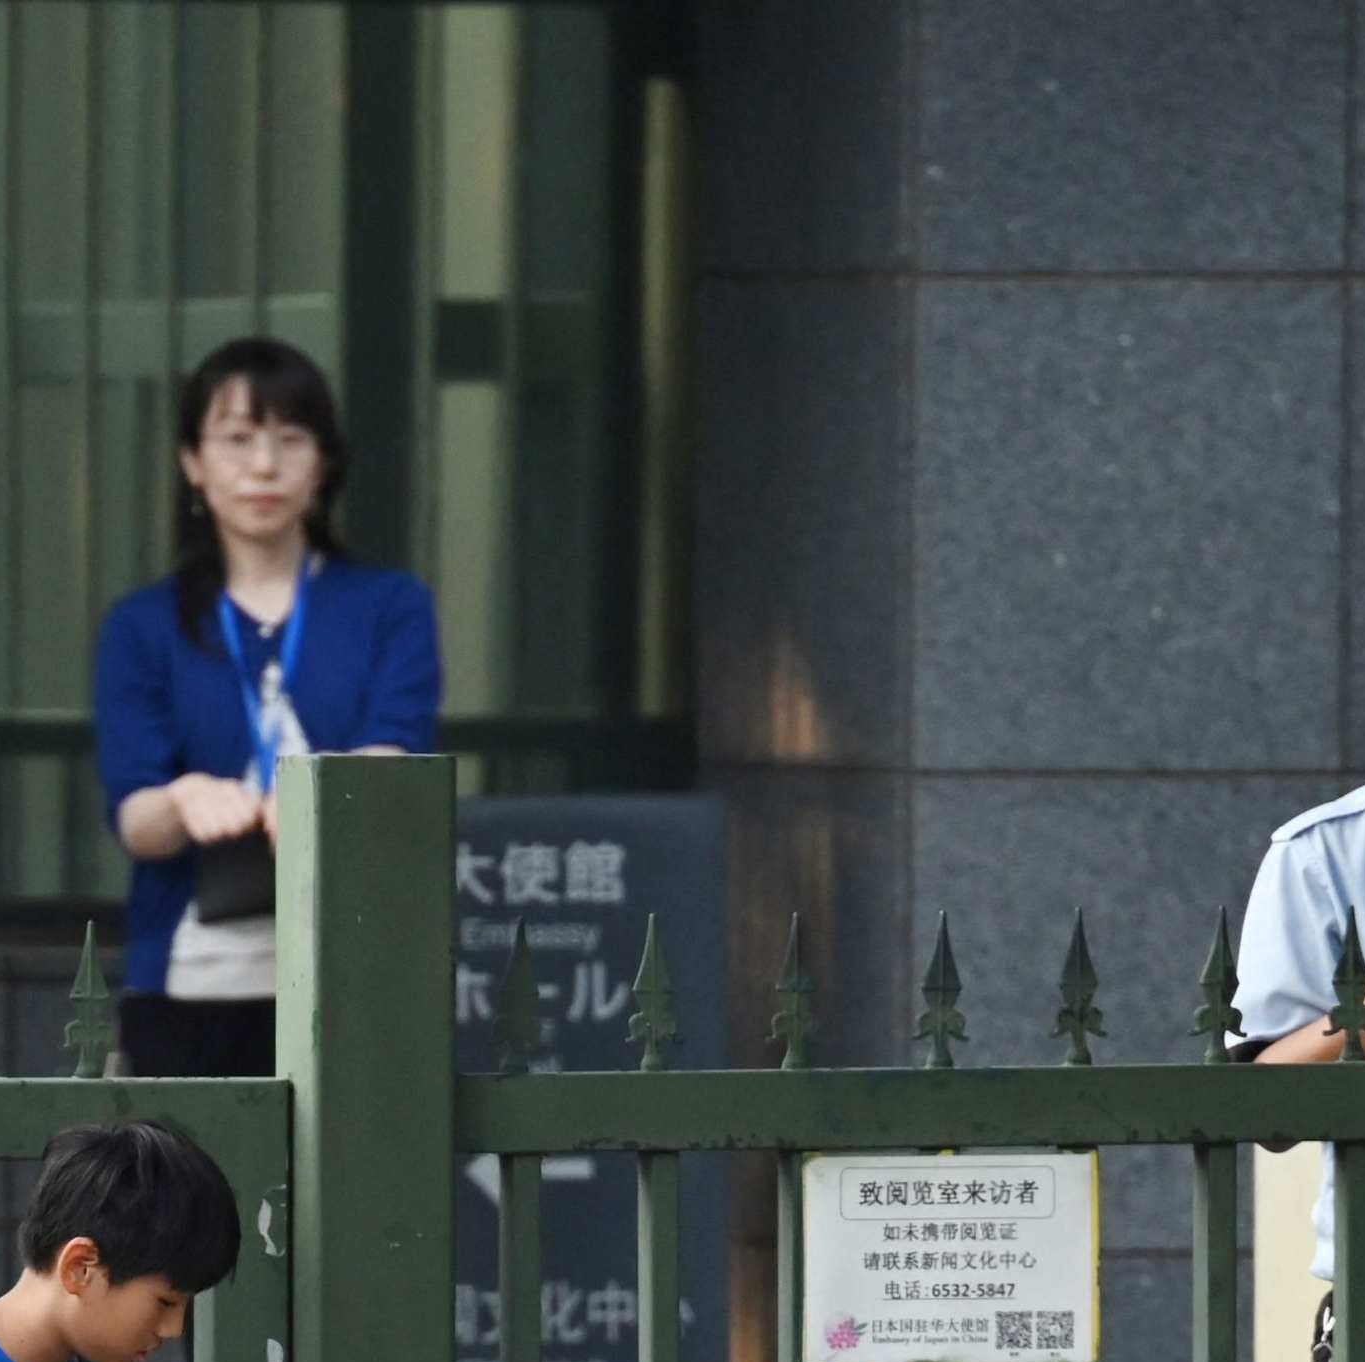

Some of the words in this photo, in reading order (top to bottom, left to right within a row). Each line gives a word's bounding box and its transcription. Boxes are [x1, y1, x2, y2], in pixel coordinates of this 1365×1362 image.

[858, 1180, 1039, 1206] 致阅览室来访者
[883, 1222, 1019, 1242] 如未携带阅览证
[863, 1251, 1037, 1272] 请联系新闻文化中心
[871, 1317, 989, 1334] 日本国驻华大使馆
